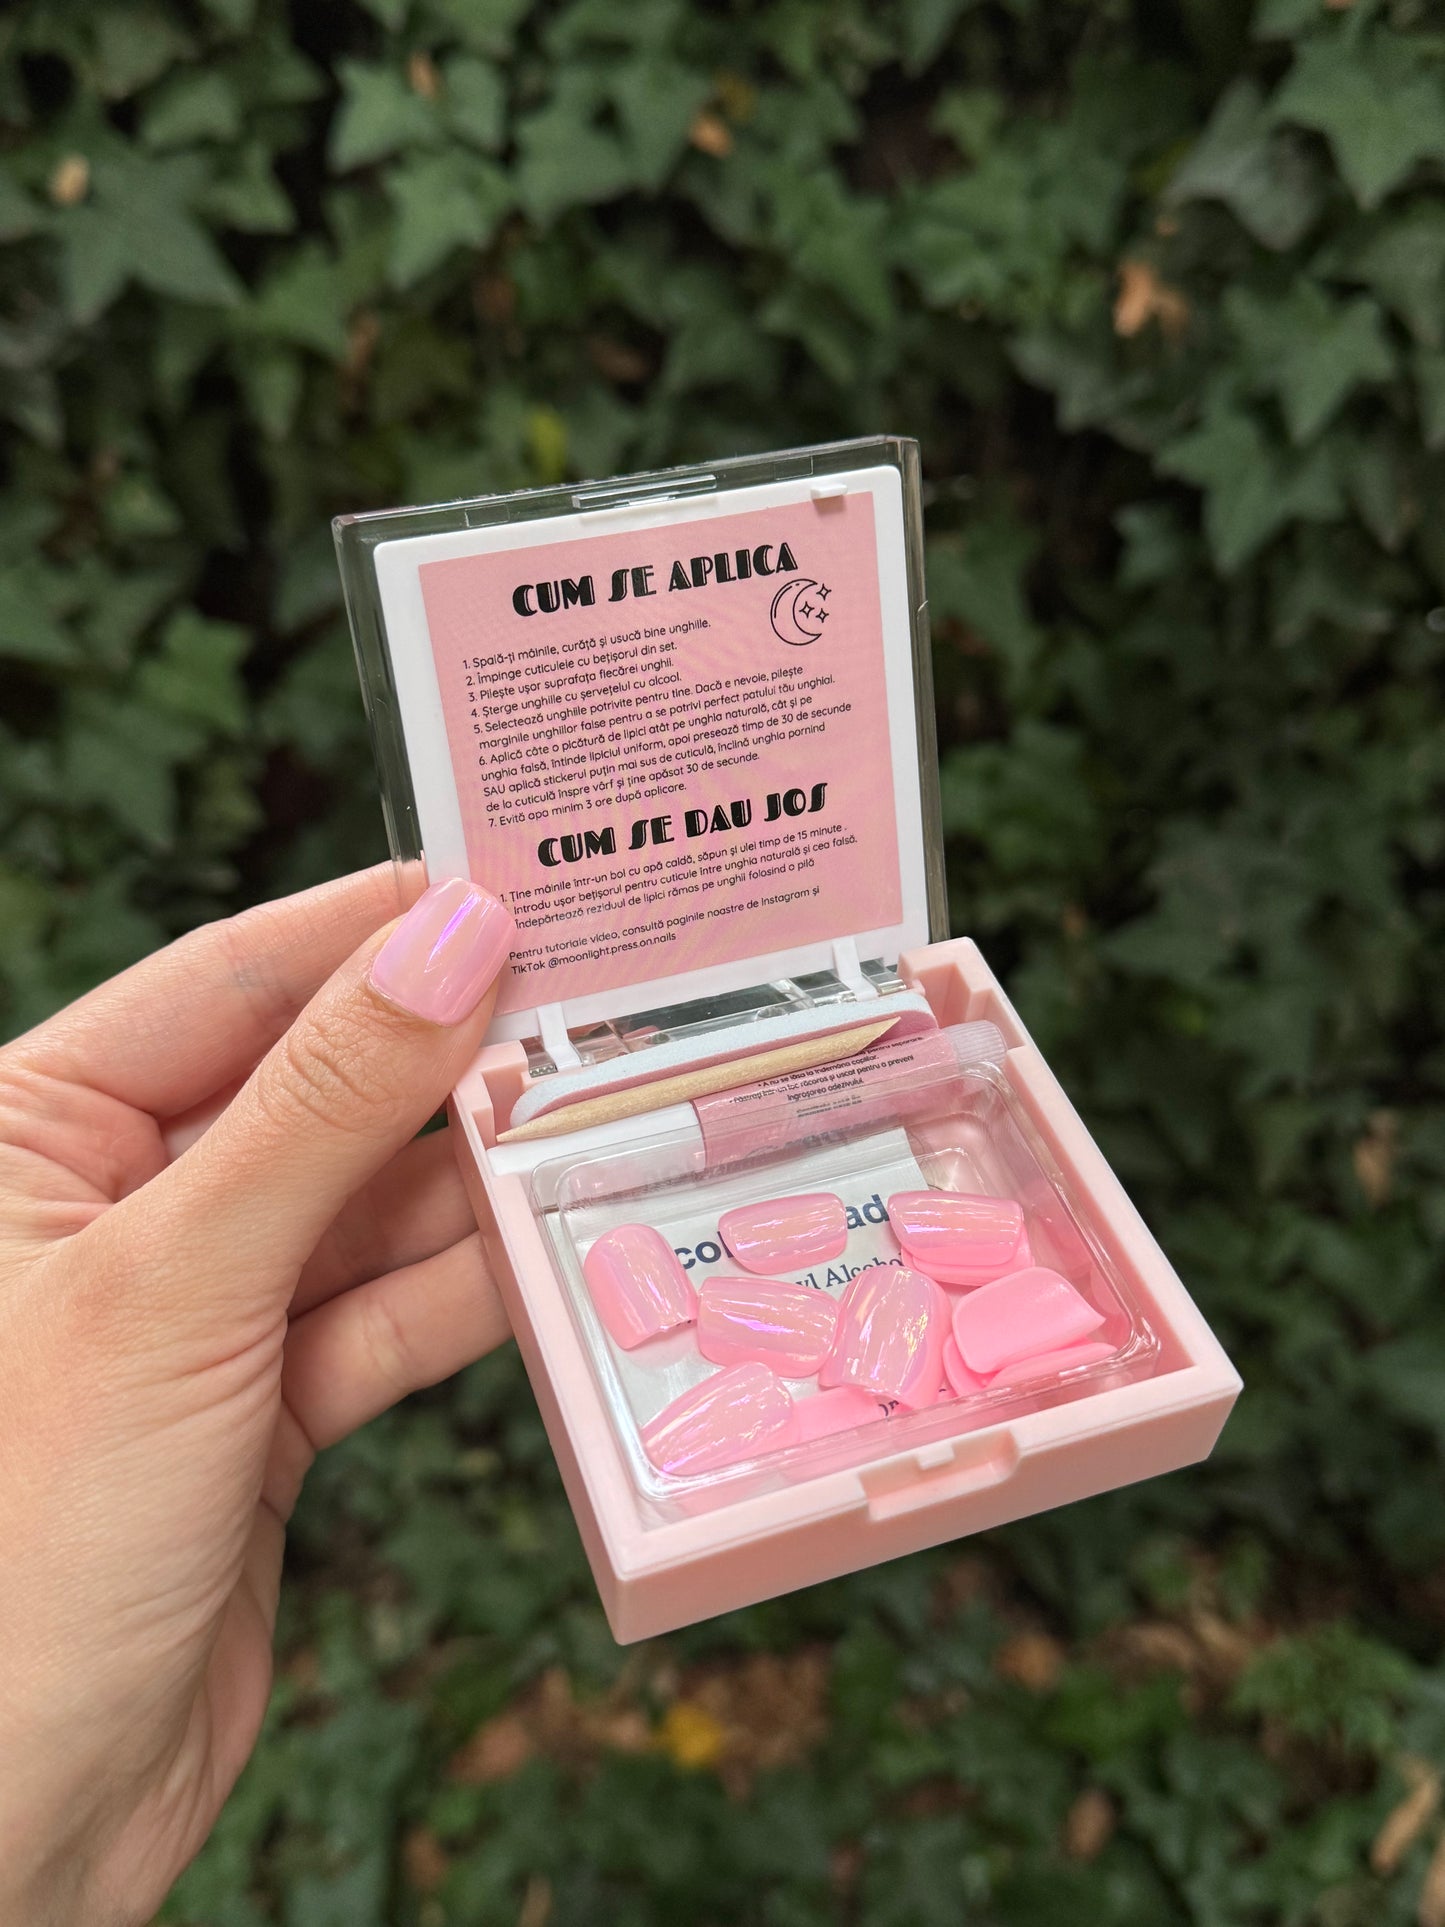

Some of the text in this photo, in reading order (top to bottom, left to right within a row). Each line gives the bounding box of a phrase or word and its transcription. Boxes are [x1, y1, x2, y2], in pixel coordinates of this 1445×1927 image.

[511, 541, 798, 617] CUM SE APLICA
[643, 627, 666, 638] bine
[668, 618, 711, 634] unghiile.
[465, 675, 475, 686] 2.
[524, 659, 574, 676] cuticulele
[577, 657, 590, 667] cu
[640, 644, 656, 656] din
[659, 641, 677, 652] set.
[468, 691, 477, 702] 3.
[640, 657, 673, 672] unghii.
[470, 671, 681, 717] 4. unghiile cu cu alcool.
[473, 723, 483, 734] 5.
[546, 705, 587, 721] unghiile
[589, 698, 632, 715] potrivite
[635, 692, 669, 707] pentru
[724, 680, 731, 688] e
[733, 672, 769, 686] nevoie,
[479, 674, 835, 749] marginile unghiilor false pentru a se potrivi perfect patului unghial.
[478, 755, 487, 766] 6.
[552, 744, 559, 752] o
[607, 731, 621, 742] de
[623, 726, 646, 740] lipici
[672, 720, 685, 732] pe
[688, 712, 722, 726] unghia
[799, 695, 812, 707] pe
[481, 767, 517, 781] unghia
[589, 746, 620, 762] lipiciul
[623, 740, 666, 755] uniform,
[667, 733, 690, 747] apoi
[741, 720, 764, 732] timp
[766, 716, 779, 727] de
[781, 713, 793, 724] 30
[795, 710, 808, 721] de
[810, 702, 851, 718] secunde
[483, 783, 505, 797] SAU
[543, 768, 586, 785] stickerul
[617, 759, 637, 771] mai
[639, 757, 657, 767] sus
[659, 753, 672, 763] de
[752, 731, 785, 745] unghia
[788, 721, 825, 740] pornind
[485, 801, 500, 812] de
[502, 799, 512, 809] la
[685, 762, 698, 773] 30
[700, 760, 714, 770] de
[716, 751, 759, 767] secunde.
[488, 817, 497, 827] 7.
[527, 809, 549, 821] apa
[551, 802, 583, 815] minim
[585, 799, 592, 809] 3
[594, 797, 612, 807] ore
[643, 783, 686, 798] aplicare.
[537, 782, 828, 867] CUM SE DAU JOS
[609, 868, 626, 880] bol
[628, 867, 640, 876] cu
[739, 841, 757, 852] ulei
[758, 837, 781, 848] timp
[782, 833, 795, 843] de
[797, 829, 807, 840] 15
[624, 879, 657, 894] pentru
[659, 869, 697, 884] cuticule
[724, 856, 757, 870] unghia
[812, 841, 830, 851] cea
[586, 898, 625, 914] reziduul
[627, 895, 641, 906] de
[643, 889, 665, 903] lipici
[701, 881, 714, 892] pe
[716, 872, 745, 886] unghii
[748, 863, 786, 880] folosind
[788, 863, 795, 871] o
[508, 947, 543, 961] Pentru
[544, 937, 587, 953] tutoriale
[589, 931, 620, 943] video,
[666, 911, 704, 928] paginile
[707, 903, 744, 918] noastre
[746, 899, 759, 909] de
[761, 889, 810, 906] Instagram
[510, 960, 545, 974] TikTok
[836, 1069, 856, 1079] uscat
[856, 1063, 881, 1075] pentru
[887, 1055, 914, 1067] preveni
